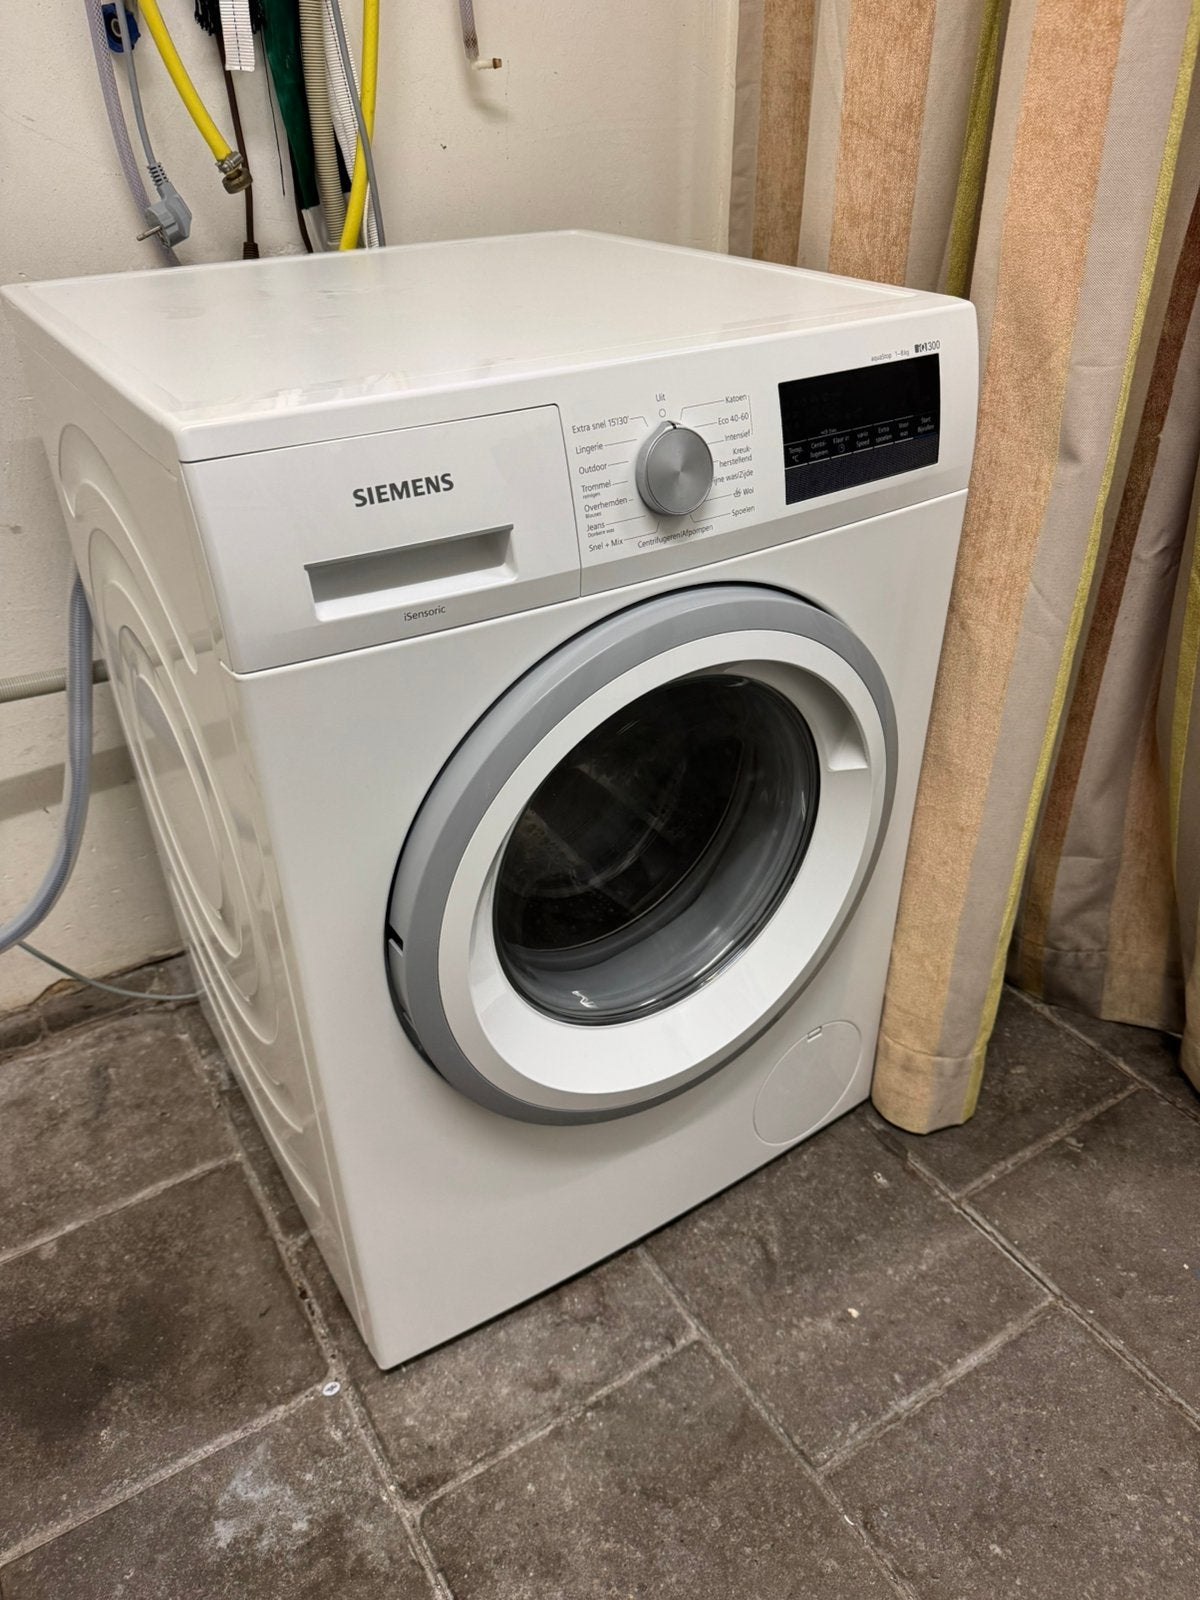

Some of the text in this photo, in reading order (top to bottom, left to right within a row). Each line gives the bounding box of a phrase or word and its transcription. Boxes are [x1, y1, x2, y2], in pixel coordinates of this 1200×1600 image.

[655, 392, 666, 402] Uit
[725, 394, 747, 404] Katoen
[718, 412, 749, 425] Eco 40-60
[572, 424, 591, 434] Extra
[592, 420, 606, 430] snel
[725, 429, 751, 441] Intensief
[575, 442, 603, 455] Lingerie
[719, 454, 752, 467] herstellend
[578, 463, 607, 475] Outdoor
[352, 473, 454, 507] SIEMENS
[581, 480, 612, 492] Trommel
[743, 486, 754, 496] Wol
[584, 497, 628, 512] Overhemden
[731, 505, 755, 517] Spoelen
[586, 522, 606, 532] Jeans
[587, 530, 606, 538] Donkere
[589, 541, 604, 552] Snel
[610, 538, 624, 547] Mix
[403, 605, 446, 621] iSensoric
